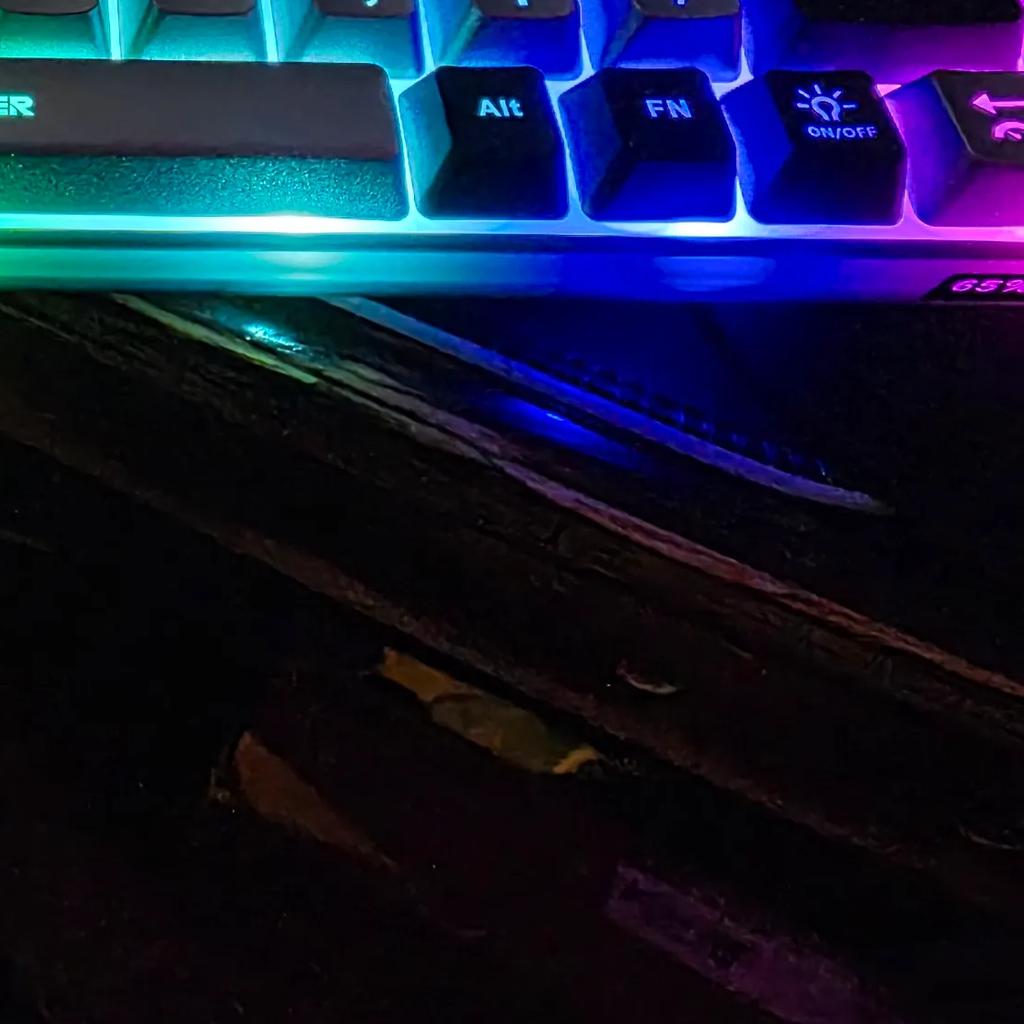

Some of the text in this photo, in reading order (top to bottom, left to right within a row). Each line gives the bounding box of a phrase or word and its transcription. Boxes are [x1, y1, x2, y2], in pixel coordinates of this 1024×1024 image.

[478, 98, 524, 118] Alt
[644, 98, 692, 119] FN
[807, 125, 877, 140] ON/OFF
